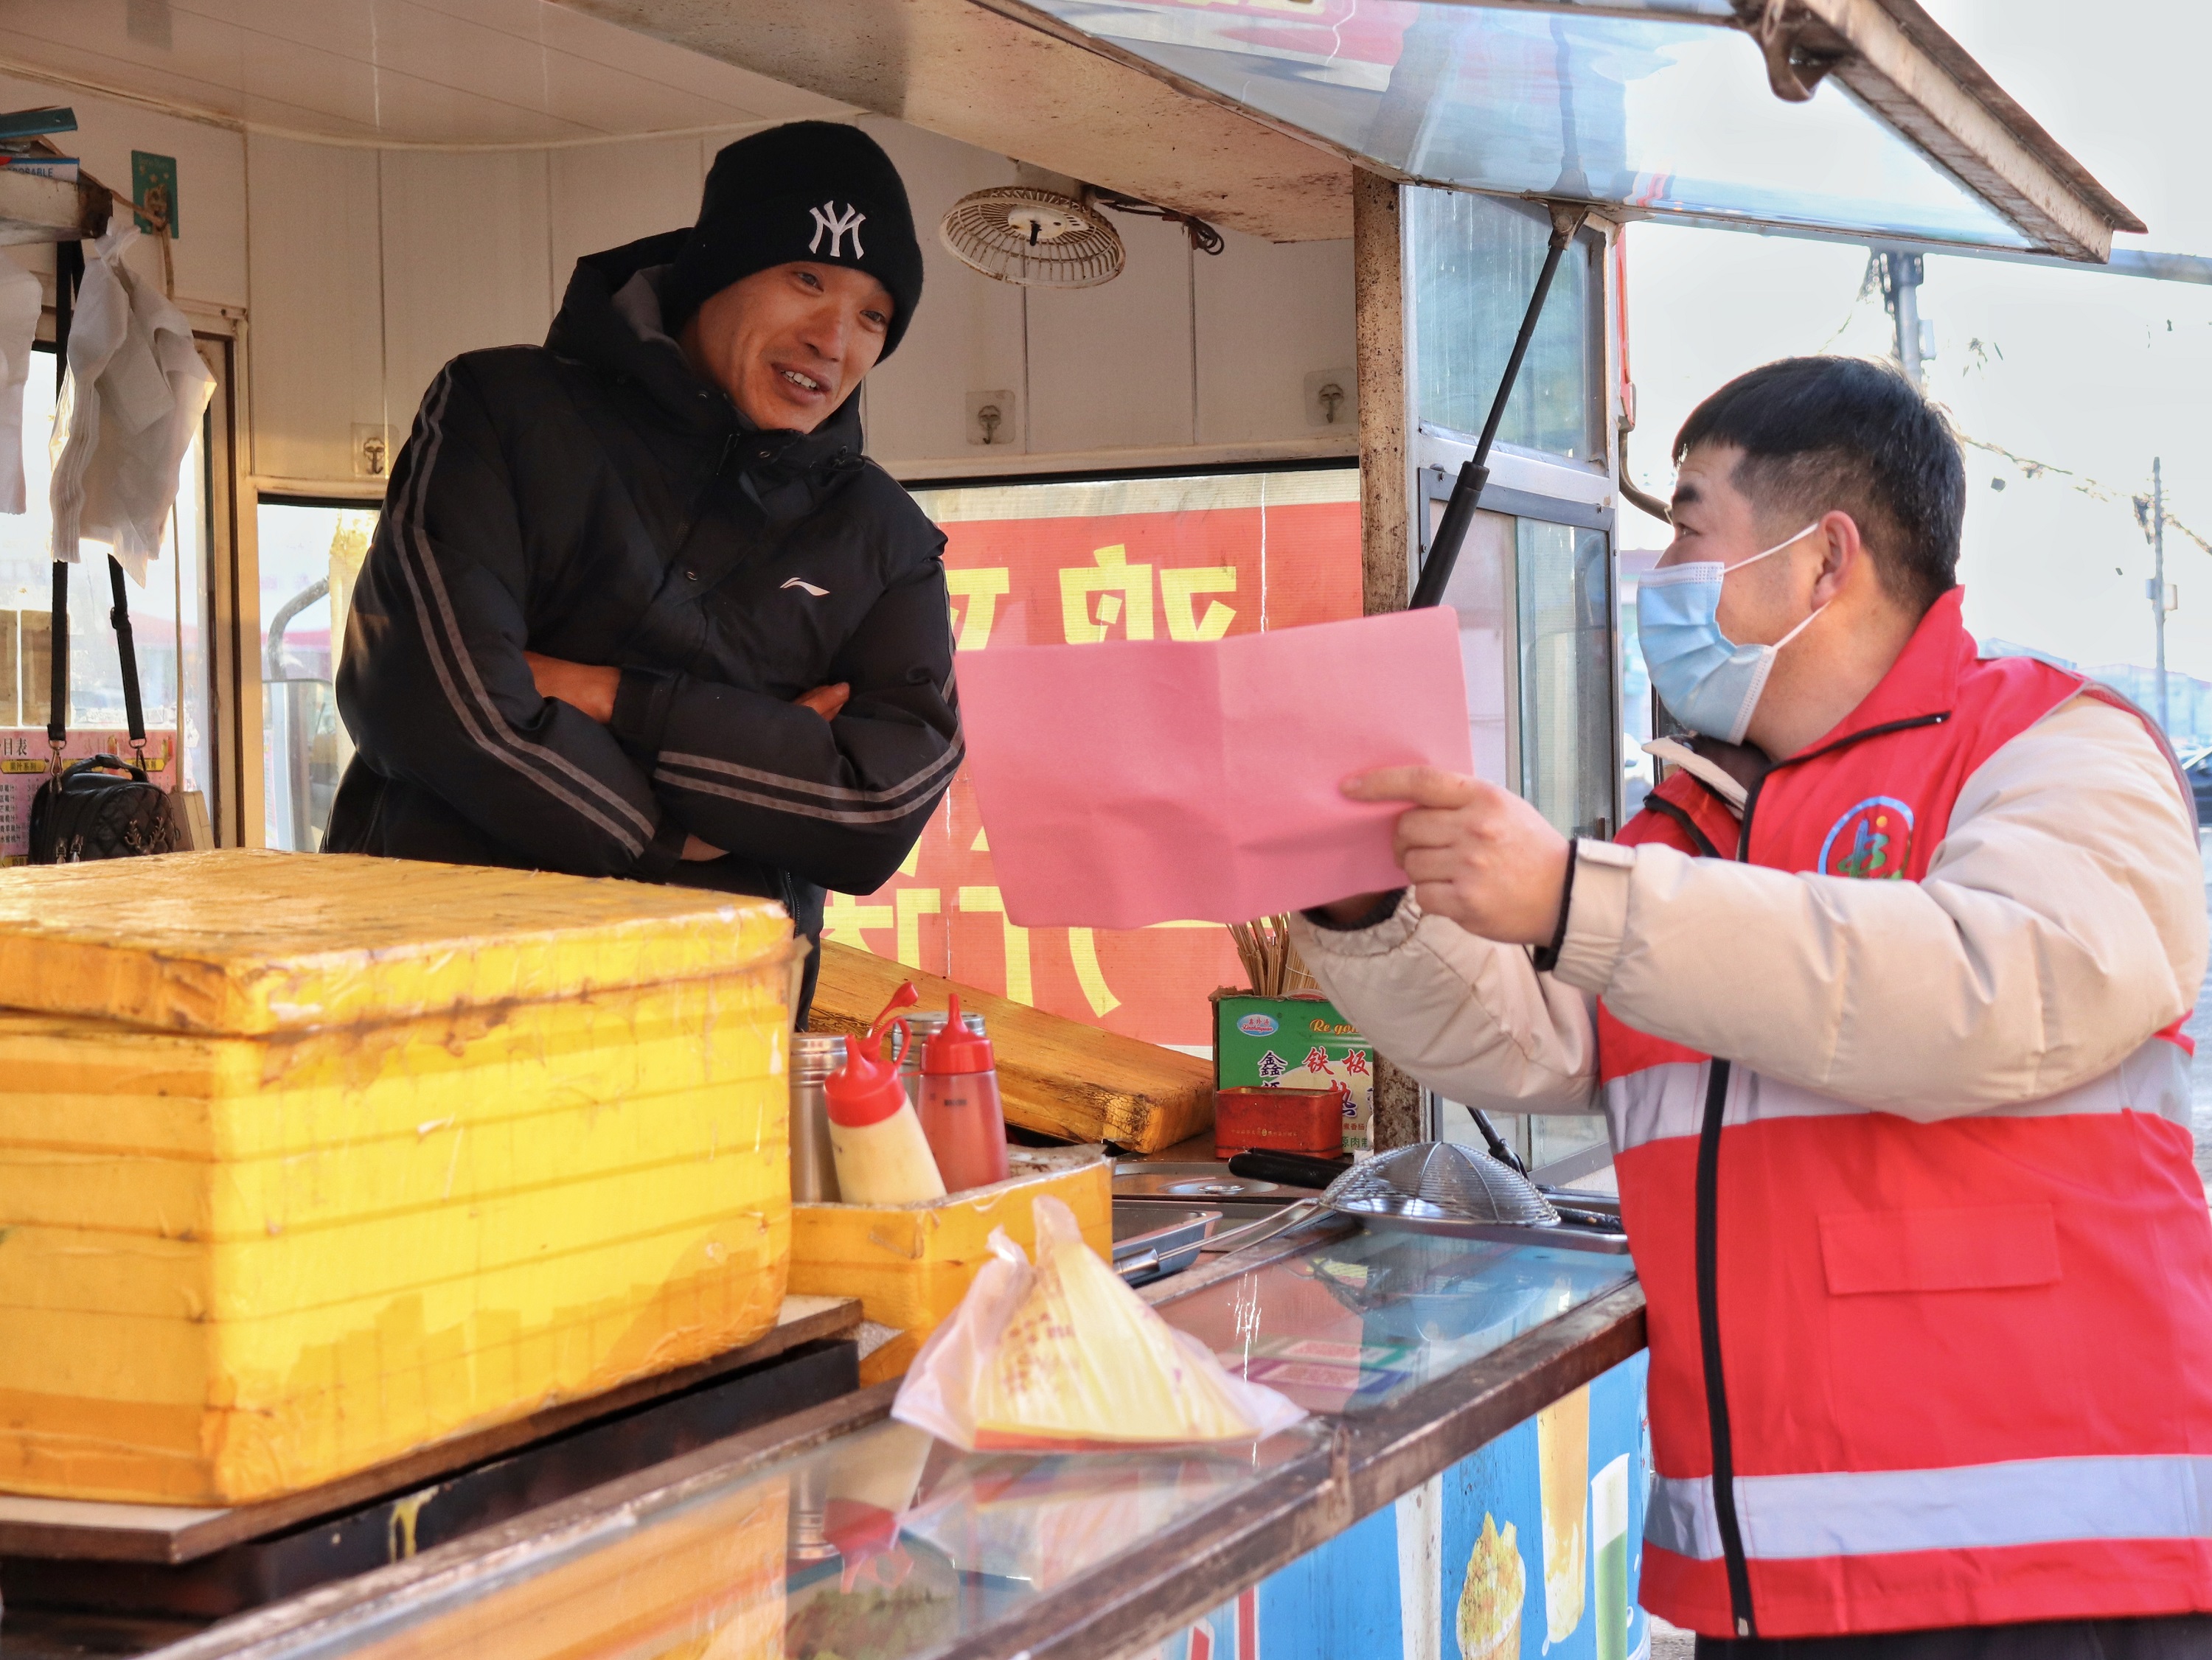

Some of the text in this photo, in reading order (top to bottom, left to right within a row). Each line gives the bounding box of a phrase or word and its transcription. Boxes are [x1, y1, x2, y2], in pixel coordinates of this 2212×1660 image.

[809, 200, 866, 259] NY
[0, 738, 27, 756] 目表
[1310, 1019, 1331, 1033] Re
[1303, 1046, 1370, 1076] 铁板
